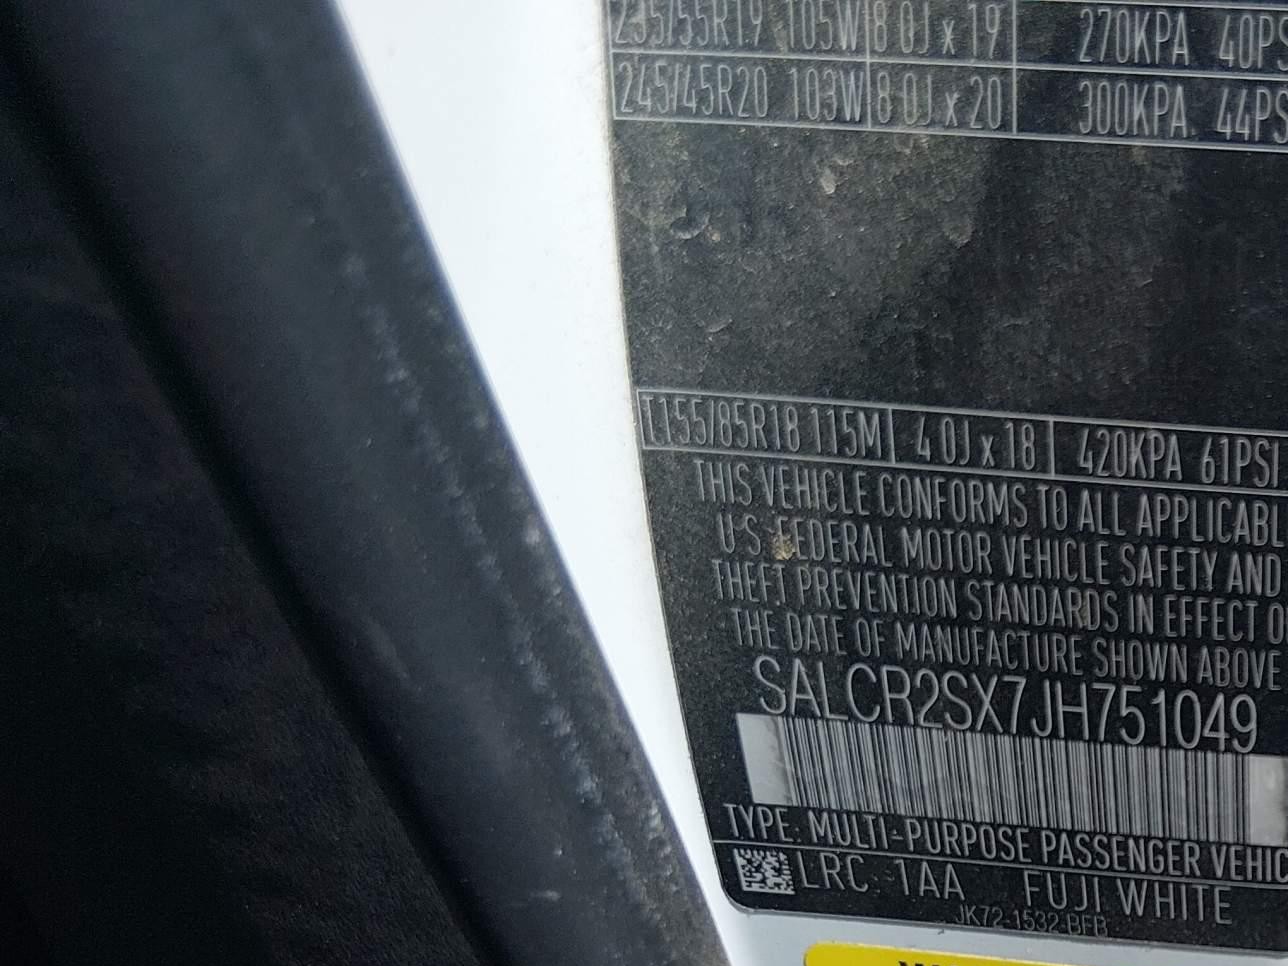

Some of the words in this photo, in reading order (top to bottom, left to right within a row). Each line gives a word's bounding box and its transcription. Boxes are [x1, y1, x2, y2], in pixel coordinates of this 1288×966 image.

[789, 0, 861, 51] 105W
[967, 4, 1000, 60] 19
[1078, 8, 1190, 66] 270KPA
[618, 61, 769, 118] 245/45R20
[788, 67, 864, 122] 103W
[969, 76, 1001, 130] 20
[1078, 80, 1189, 138] 300KPA
[642, 396, 801, 452] T155/85R18
[809, 406, 882, 460] 115M
[1003, 420, 1036, 470] 18
[1079, 427, 1183, 481] 420KPA
[1200, 436, 1280, 488] 61PSI
[693, 458, 753, 506] THIS
[759, 464, 871, 517] VEHICLE
[877, 472, 1029, 529] CONFORMS
[1036, 485, 1069, 532] TO
[1076, 487, 1128, 537] ALL
[777, 515, 894, 568] FEDERAL
[900, 526, 994, 575] MOTOR
[1000, 534, 1112, 586] VEHICLE
[1119, 542, 1219, 593] SAFETY
[1225, 551, 1283, 598] AND
[711, 558, 787, 603] THEFT
[798, 566, 958, 619] PREVENTION
[966, 578, 1120, 633] STANDARDS
[1127, 591, 1154, 636] IN
[1163, 593, 1260, 644] EFFECT
[730, 606, 781, 650] THE
[785, 611, 848, 656] DATE
[854, 616, 887, 658] OF
[894, 620, 1084, 677] MANUFACTURE
[1090, 636, 1189, 685] SHOWN
[1198, 645, 1282, 692] ABOVE
[806, 808, 1034, 864] MULTI-PURPOSE
[1039, 829, 1202, 878] PASSENGER
[894, 857, 967, 902] 1AA
[1022, 868, 1102, 914] FUJI
[1115, 876, 1234, 926] WHITE
